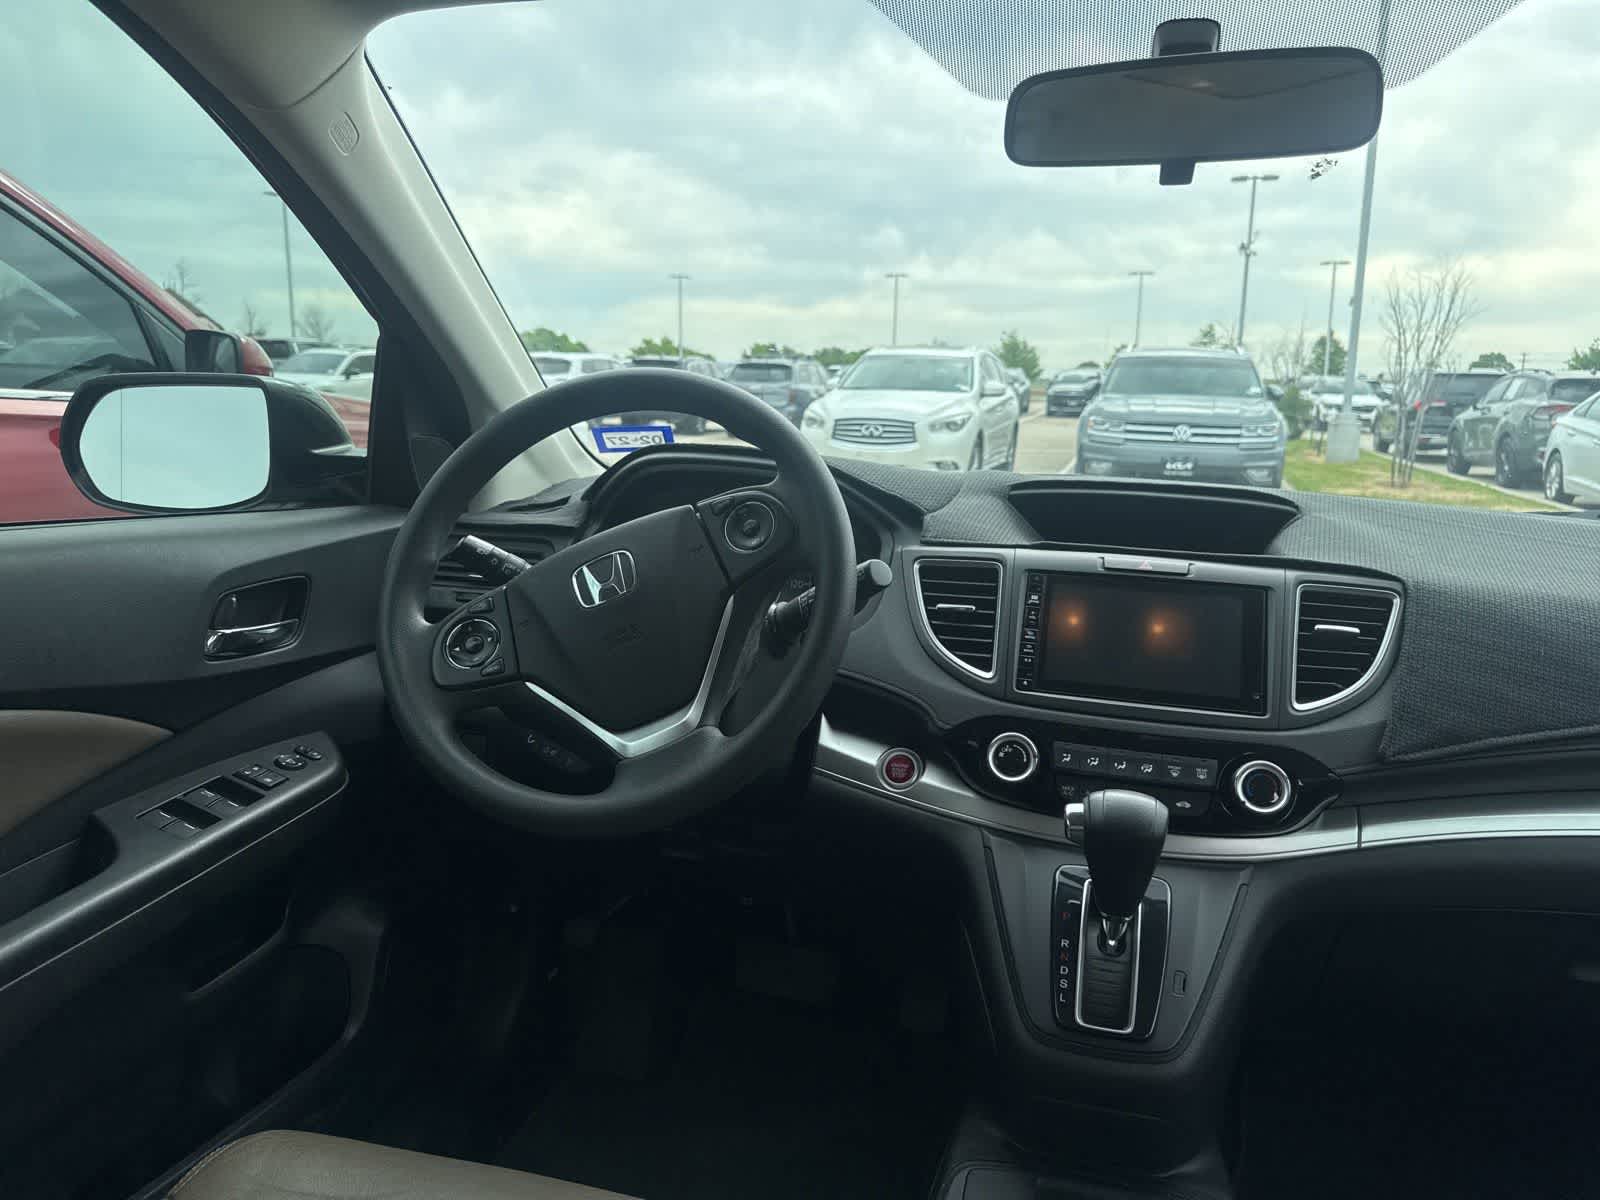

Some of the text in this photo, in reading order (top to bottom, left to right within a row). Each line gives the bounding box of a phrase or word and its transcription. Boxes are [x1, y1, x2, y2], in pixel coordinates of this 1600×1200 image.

[1061, 939, 1070, 948] R
[1060, 966, 1069, 975] D
[1059, 979, 1068, 989] S
[1059, 993, 1066, 1002] L
